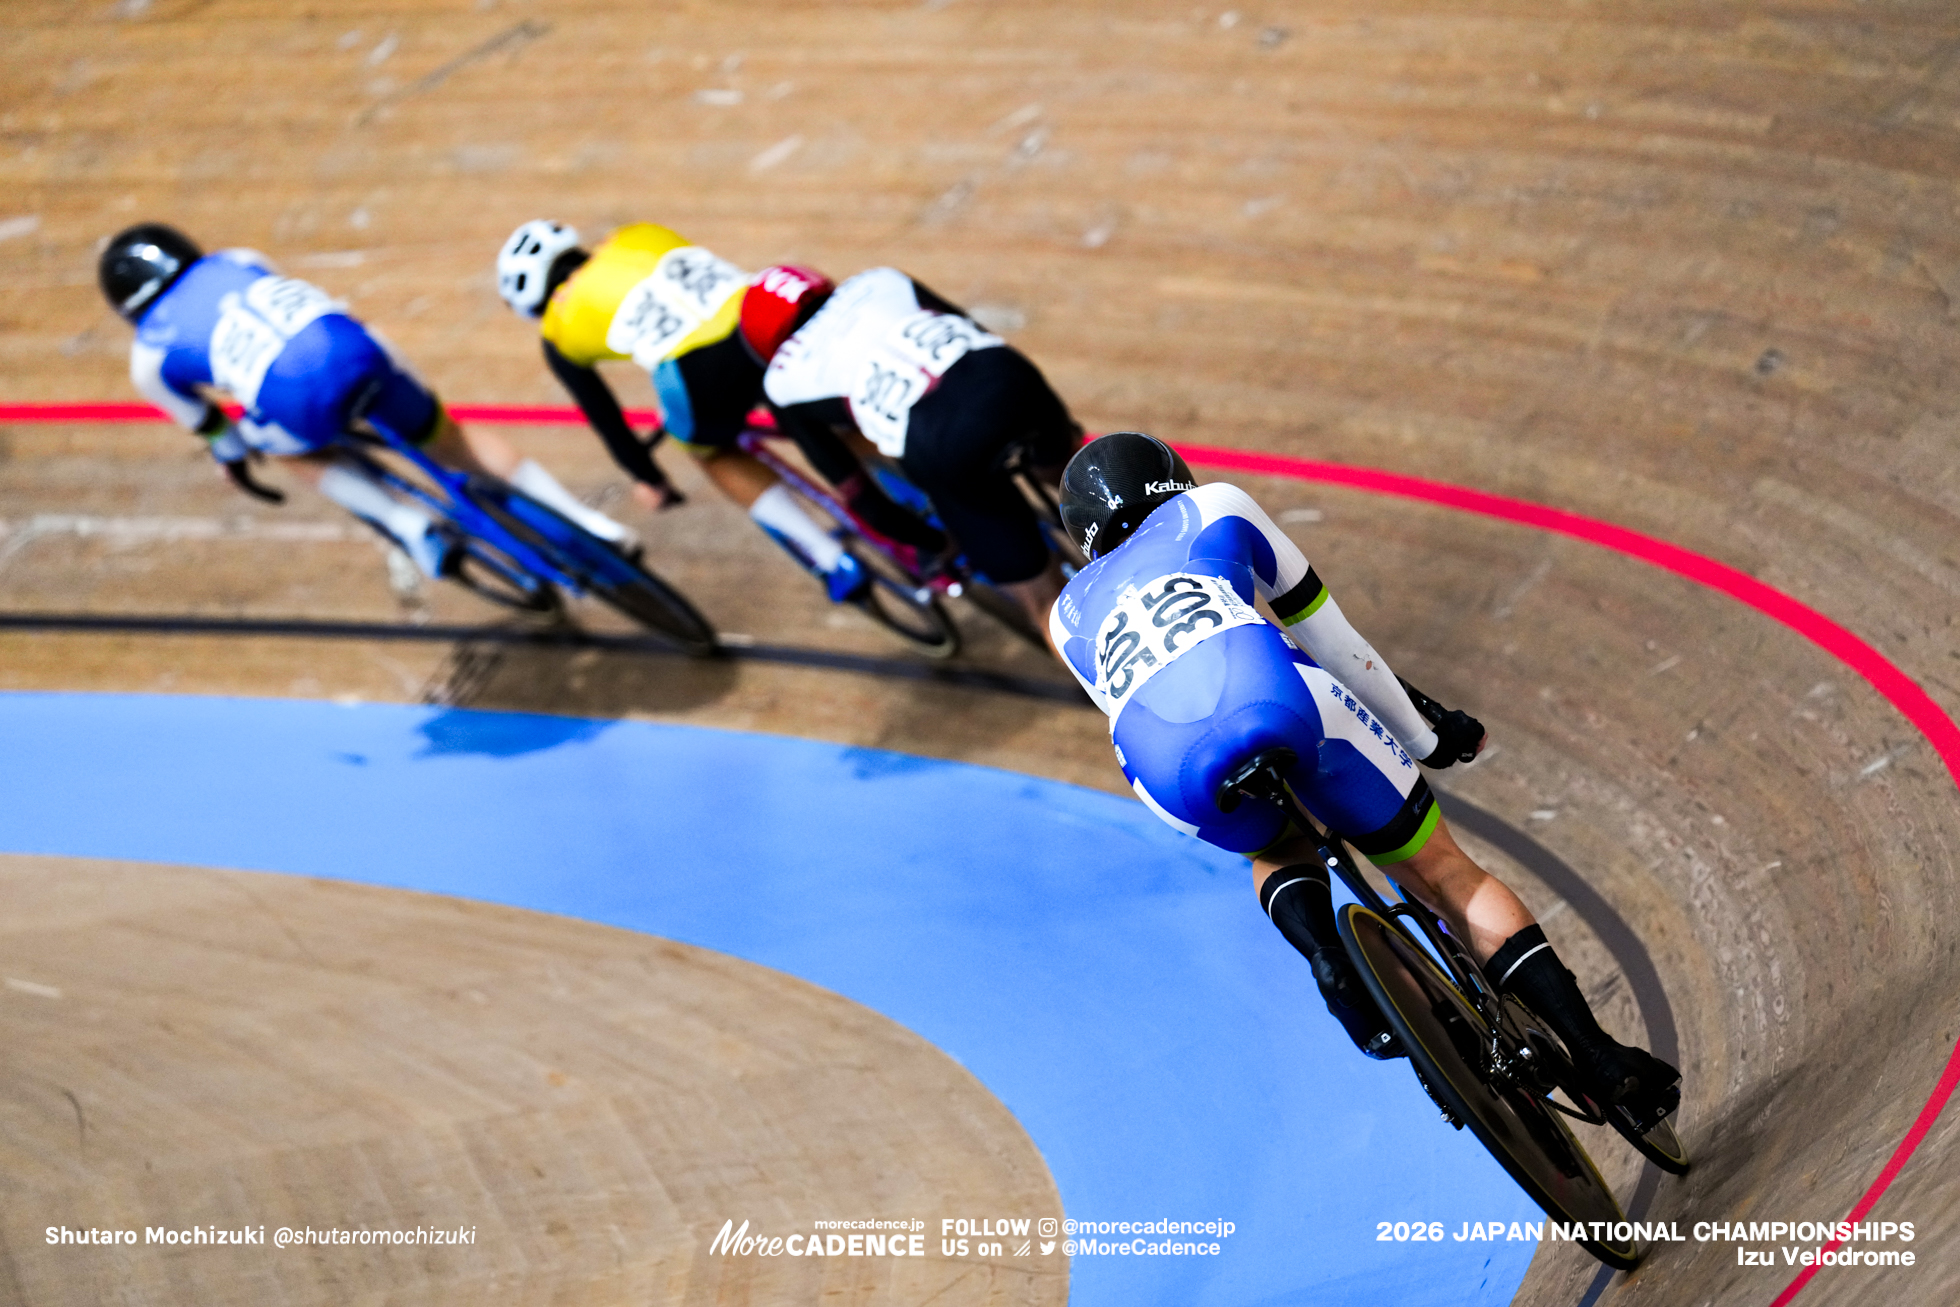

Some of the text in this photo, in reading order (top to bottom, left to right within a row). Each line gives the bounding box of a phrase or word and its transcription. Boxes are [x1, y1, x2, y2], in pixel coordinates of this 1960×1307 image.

[1098, 611, 1158, 700] 305
[1140, 576, 1224, 654] 305
[1330, 682, 1413, 769] 京都産業大学
